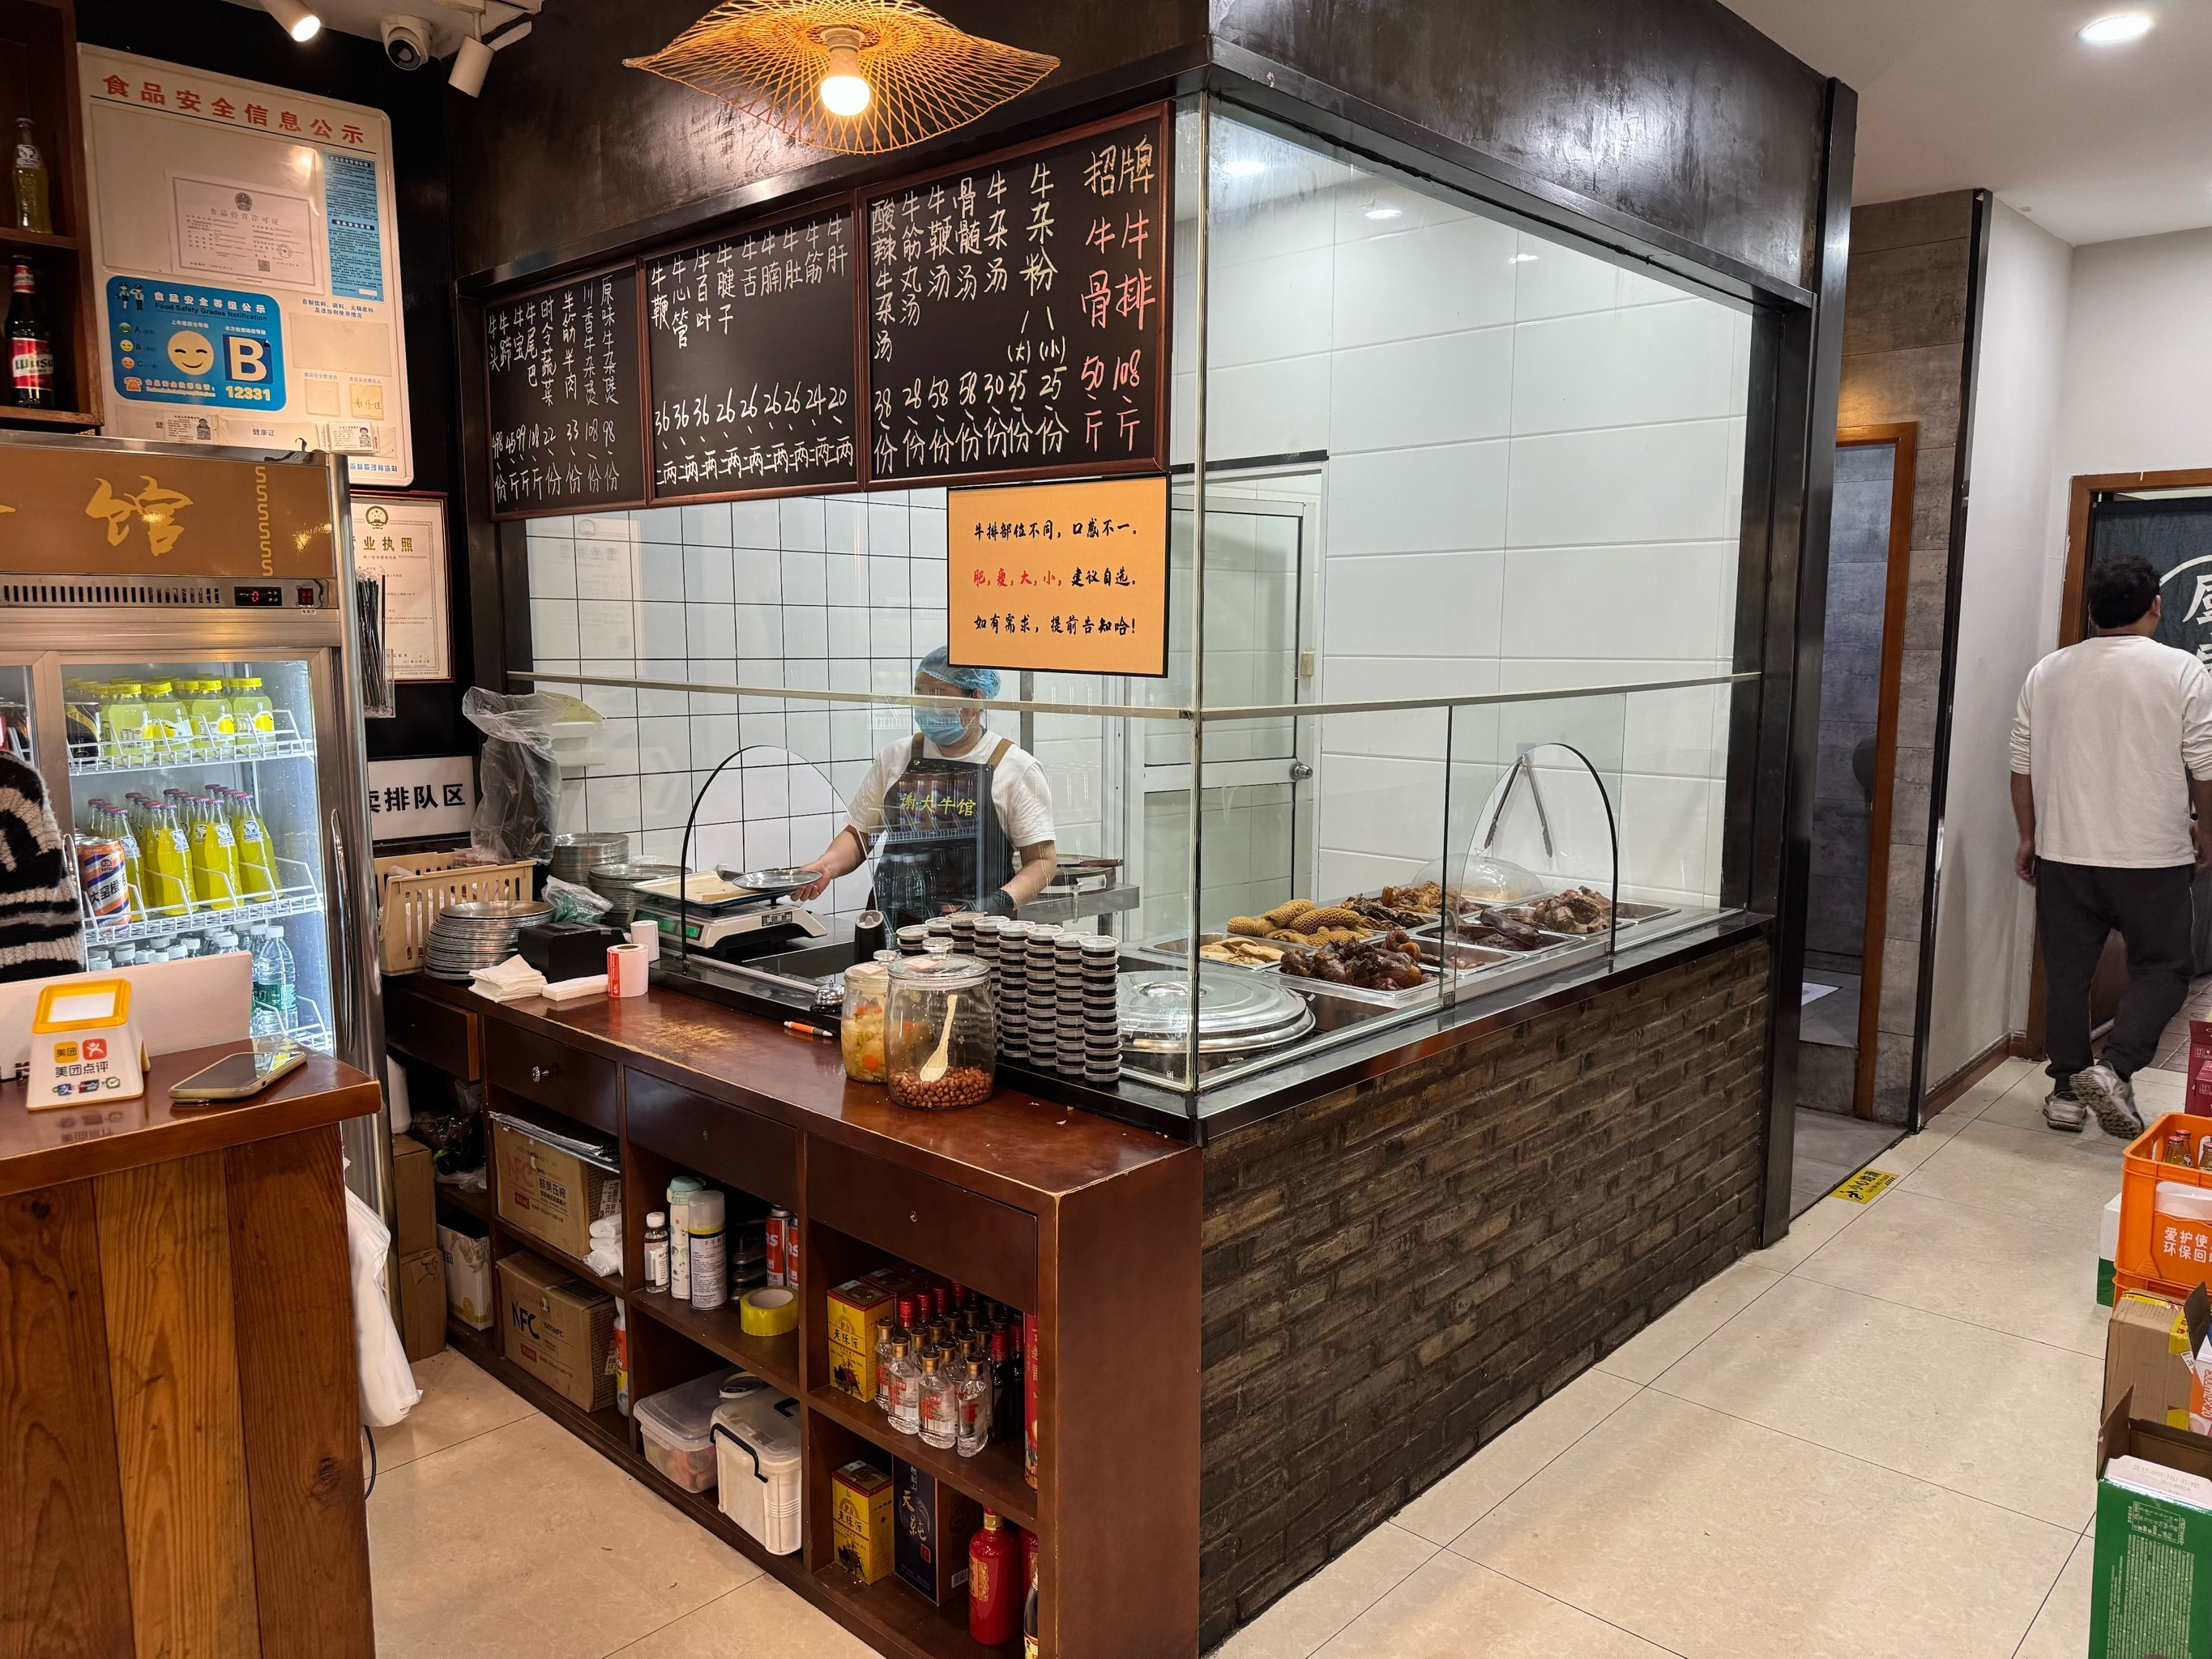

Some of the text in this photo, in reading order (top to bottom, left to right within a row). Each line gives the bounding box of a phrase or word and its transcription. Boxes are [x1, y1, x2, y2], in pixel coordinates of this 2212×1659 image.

[102, 74, 365, 145] 食品安全信息公示
[1083, 134, 1155, 198] 招牌
[211, 207, 279, 225] 食品经营许可证
[984, 169, 1008, 293] 牛杂汤
[1019, 162, 1058, 296] 牛杂粉
[804, 220, 824, 284] 牛筋
[826, 212, 848, 277] 牛肝
[925, 185, 954, 301] 牛鞭汤
[953, 177, 983, 301] 骨髓汤
[741, 235, 758, 297] 牛舌
[760, 230, 782, 297] 牛腩
[782, 227, 804, 290] 牛肚
[899, 190, 924, 326] 牛筋丸汤
[1080, 216, 1116, 329] 牛骨
[1114, 208, 1156, 331] 牛排
[651, 261, 670, 331] 牛鞭
[694, 249, 711, 332] 牛百叶
[716, 243, 737, 335] 牛腱子
[871, 197, 897, 362] 酸辣牛杂汤
[154, 291, 266, 313] 食品安全等级公示
[156, 303, 267, 322] Food Safety Grades Notification
[672, 255, 691, 349] 牛心管
[488, 314, 500, 372] 牛头
[514, 305, 526, 360] 牛宝
[525, 301, 538, 387] 牛尾巴
[582, 282, 599, 406] 川香牛杂煲
[600, 275, 619, 404] 原味牛杂煲
[228, 336, 267, 382] B
[540, 295, 557, 407] 时令蔬菜
[1009, 369, 1028, 403] 35
[1040, 366, 1067, 400] 25
[1080, 355, 1104, 391] 50
[1113, 348, 1141, 391] 108
[225, 386, 271, 401] 12331
[716, 387, 736, 424] 26
[741, 382, 758, 418] 26
[763, 382, 781, 415] 26
[784, 382, 801, 414] 26
[805, 383, 826, 416] 24
[828, 387, 847, 411] 20
[874, 388, 892, 421] 38
[903, 377, 921, 409] 28
[928, 375, 950, 408] 58
[959, 370, 977, 406] 58
[984, 373, 1004, 403] 30
[655, 400, 670, 435] 36
[673, 399, 690, 430] 36
[694, 394, 710, 427] 36
[252, 428, 275, 437] 健康证
[506, 432, 515, 454] 45
[528, 423, 540, 449] 108
[543, 427, 556, 445] 22
[566, 420, 579, 441] 33
[586, 418, 598, 441] 108
[603, 420, 616, 448] 98
[85, 476, 194, 557] 馆
[353, 536, 413, 552] 业执照
[900, 792, 977, 817] 谢大牛馆
[55, 1061, 109, 1078] 美团点评
[57, 1047, 77, 1057] 美团
[2165, 1226, 2212, 1250] 爱护使
[511, 1301, 540, 1340] NFC
